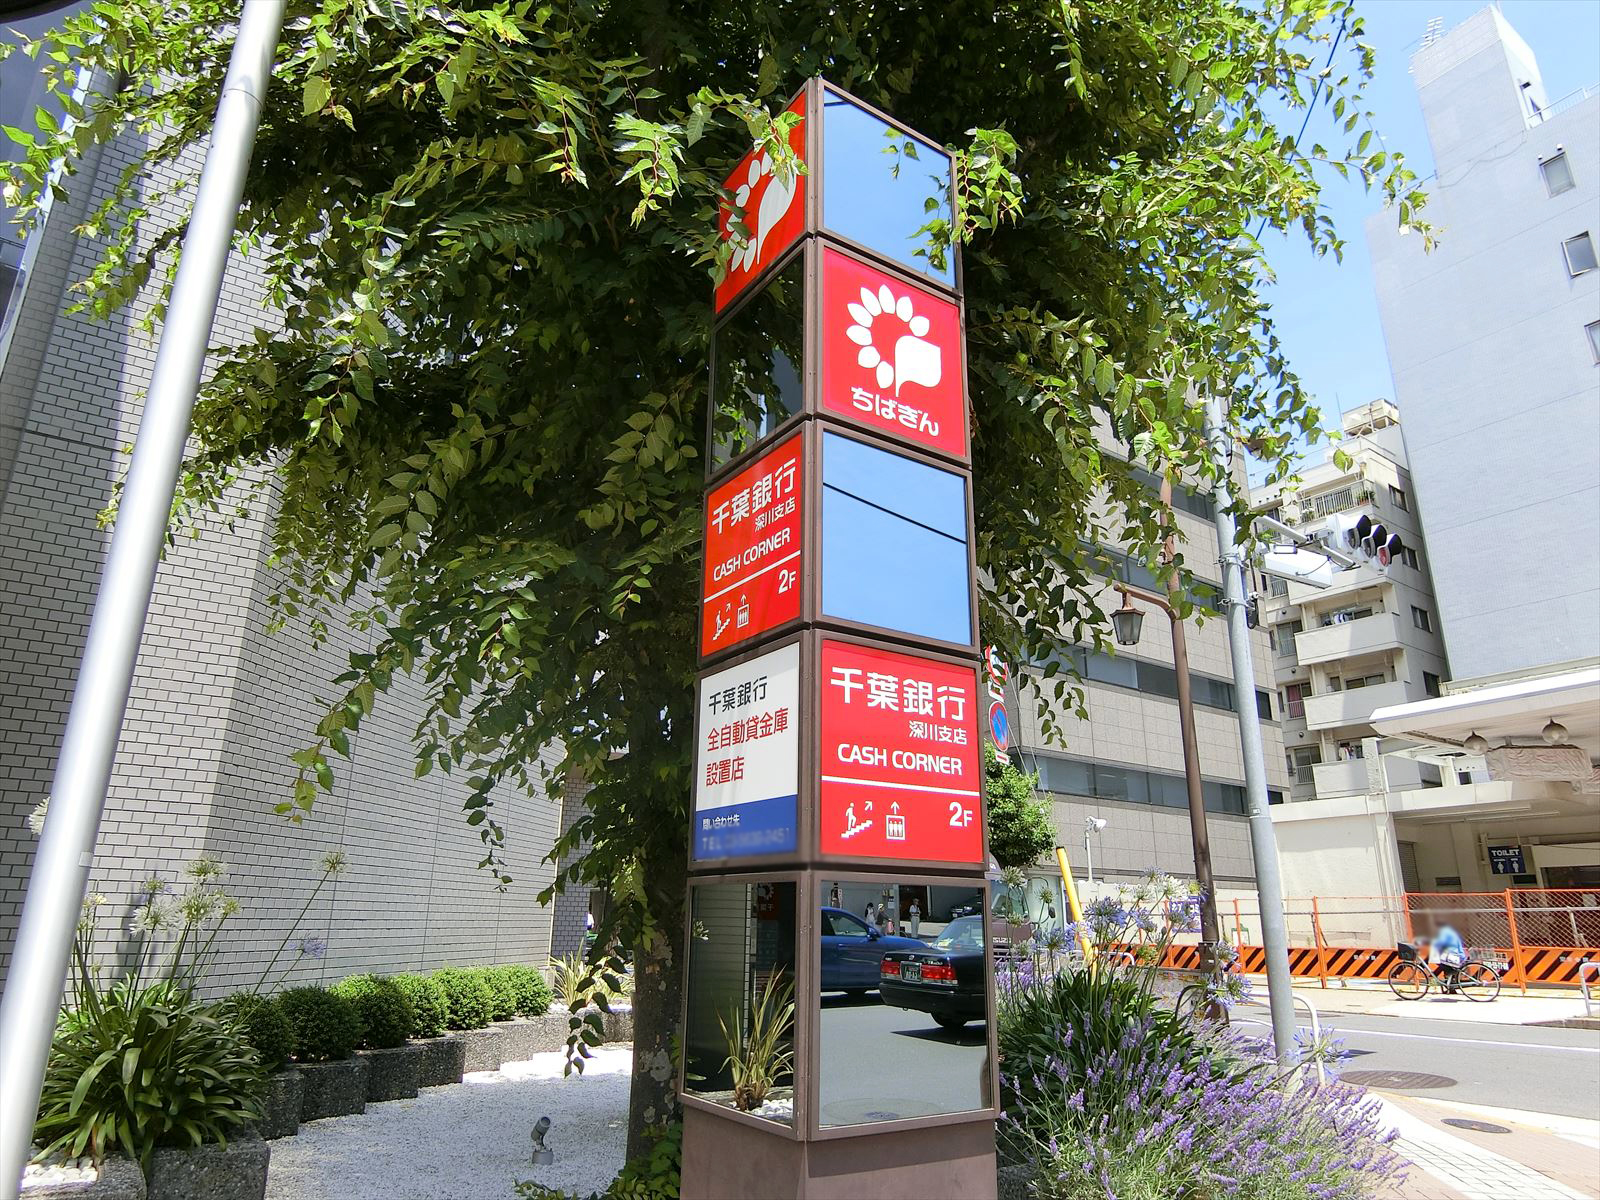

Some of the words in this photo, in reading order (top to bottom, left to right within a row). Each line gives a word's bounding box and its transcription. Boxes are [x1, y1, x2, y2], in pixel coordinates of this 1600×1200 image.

[851, 386, 939, 437] ちばぎん
[712, 458, 796, 535] 千葉銀行
[755, 496, 796, 533] 深川支店
[713, 554, 741, 582] CASH
[743, 527, 791, 566] CORNER
[778, 570, 797, 594] 2F
[708, 675, 768, 716] 千葉銀行
[831, 666, 966, 721] 千葉銀行
[707, 707, 789, 752] 全自動貸金庫
[909, 720, 967, 745] 深川支店
[705, 756, 745, 788] 設置店
[837, 743, 887, 767] CASH
[892, 750, 963, 776] CORNER
[948, 801, 973, 827] 2F
[1491, 849, 1520, 857] TOILET
